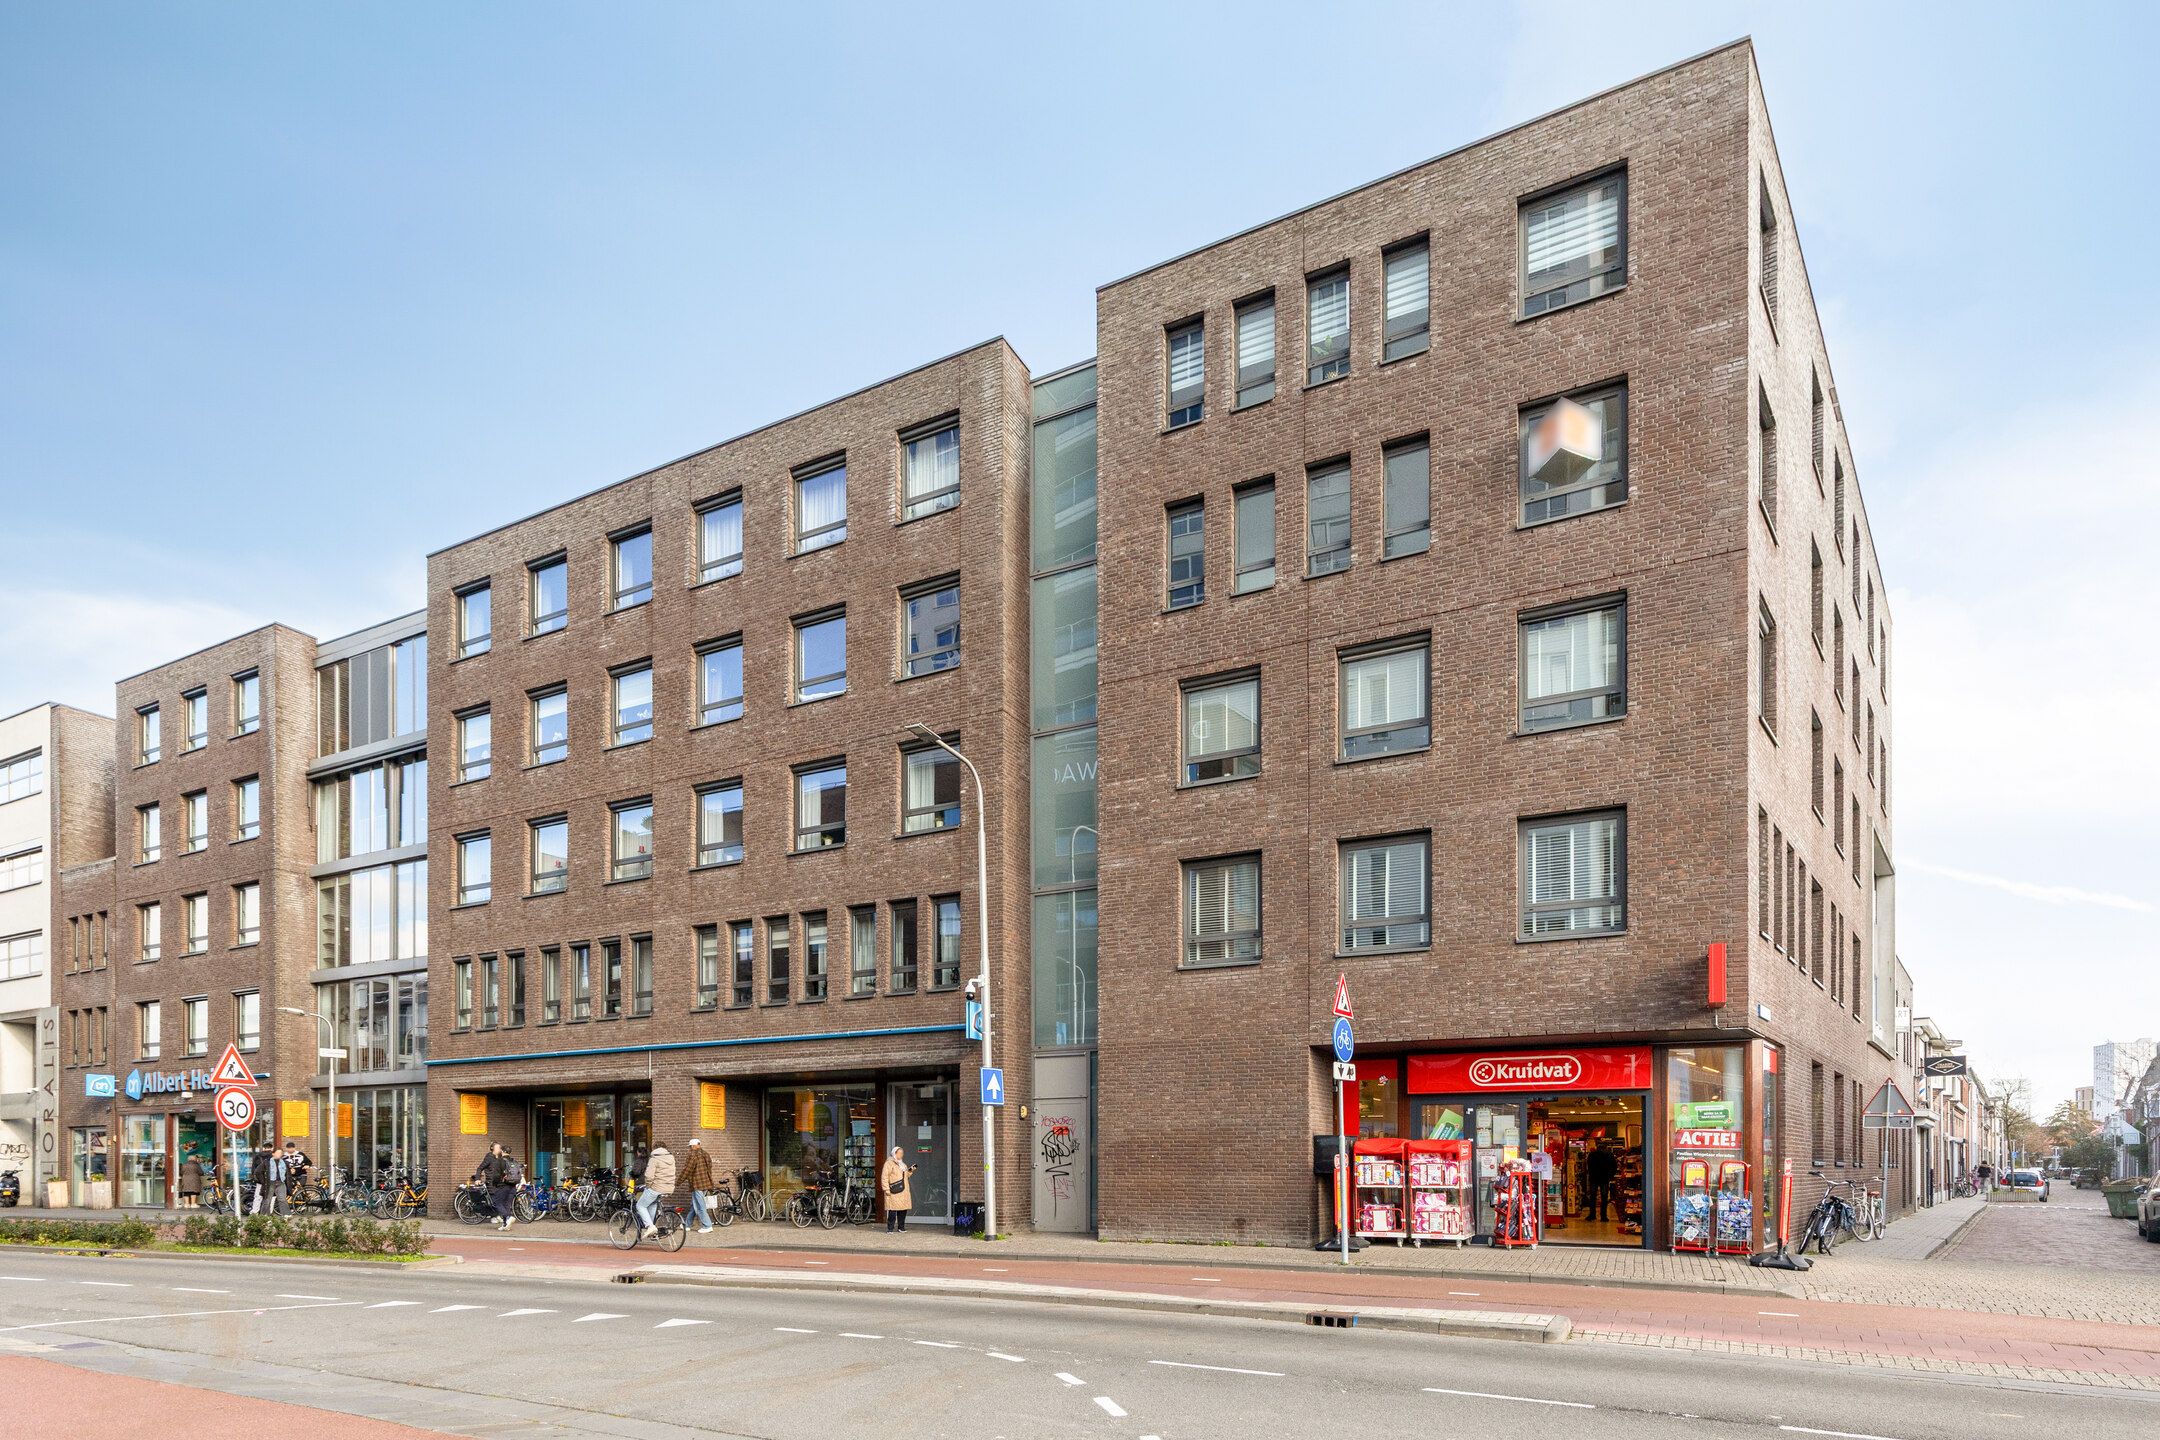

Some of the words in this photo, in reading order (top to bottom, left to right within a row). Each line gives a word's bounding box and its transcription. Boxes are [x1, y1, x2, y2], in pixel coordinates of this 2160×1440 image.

[1497, 1062, 1573, 1080] Kruidvat
[142, 1071, 187, 1094] Albert
[190, 1067, 224, 1095] Hei
[223, 1100, 249, 1119] 30
[1679, 1131, 1737, 1147] ACTIE!
